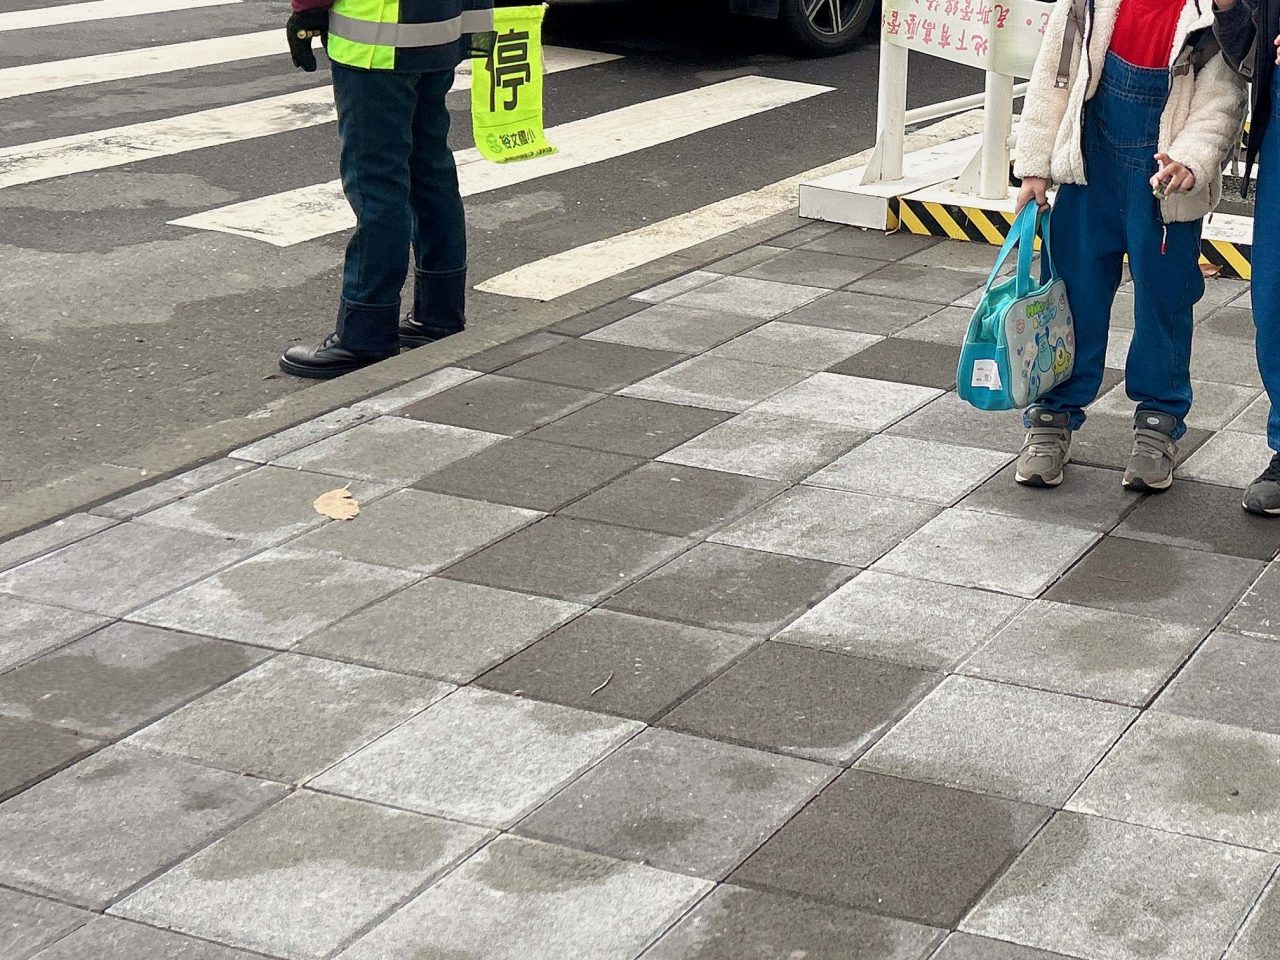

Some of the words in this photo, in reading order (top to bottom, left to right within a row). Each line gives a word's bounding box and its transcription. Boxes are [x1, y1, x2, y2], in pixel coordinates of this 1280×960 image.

[882, 9, 990, 58] 地下有高壓管
[485, 28, 531, 112] 停
